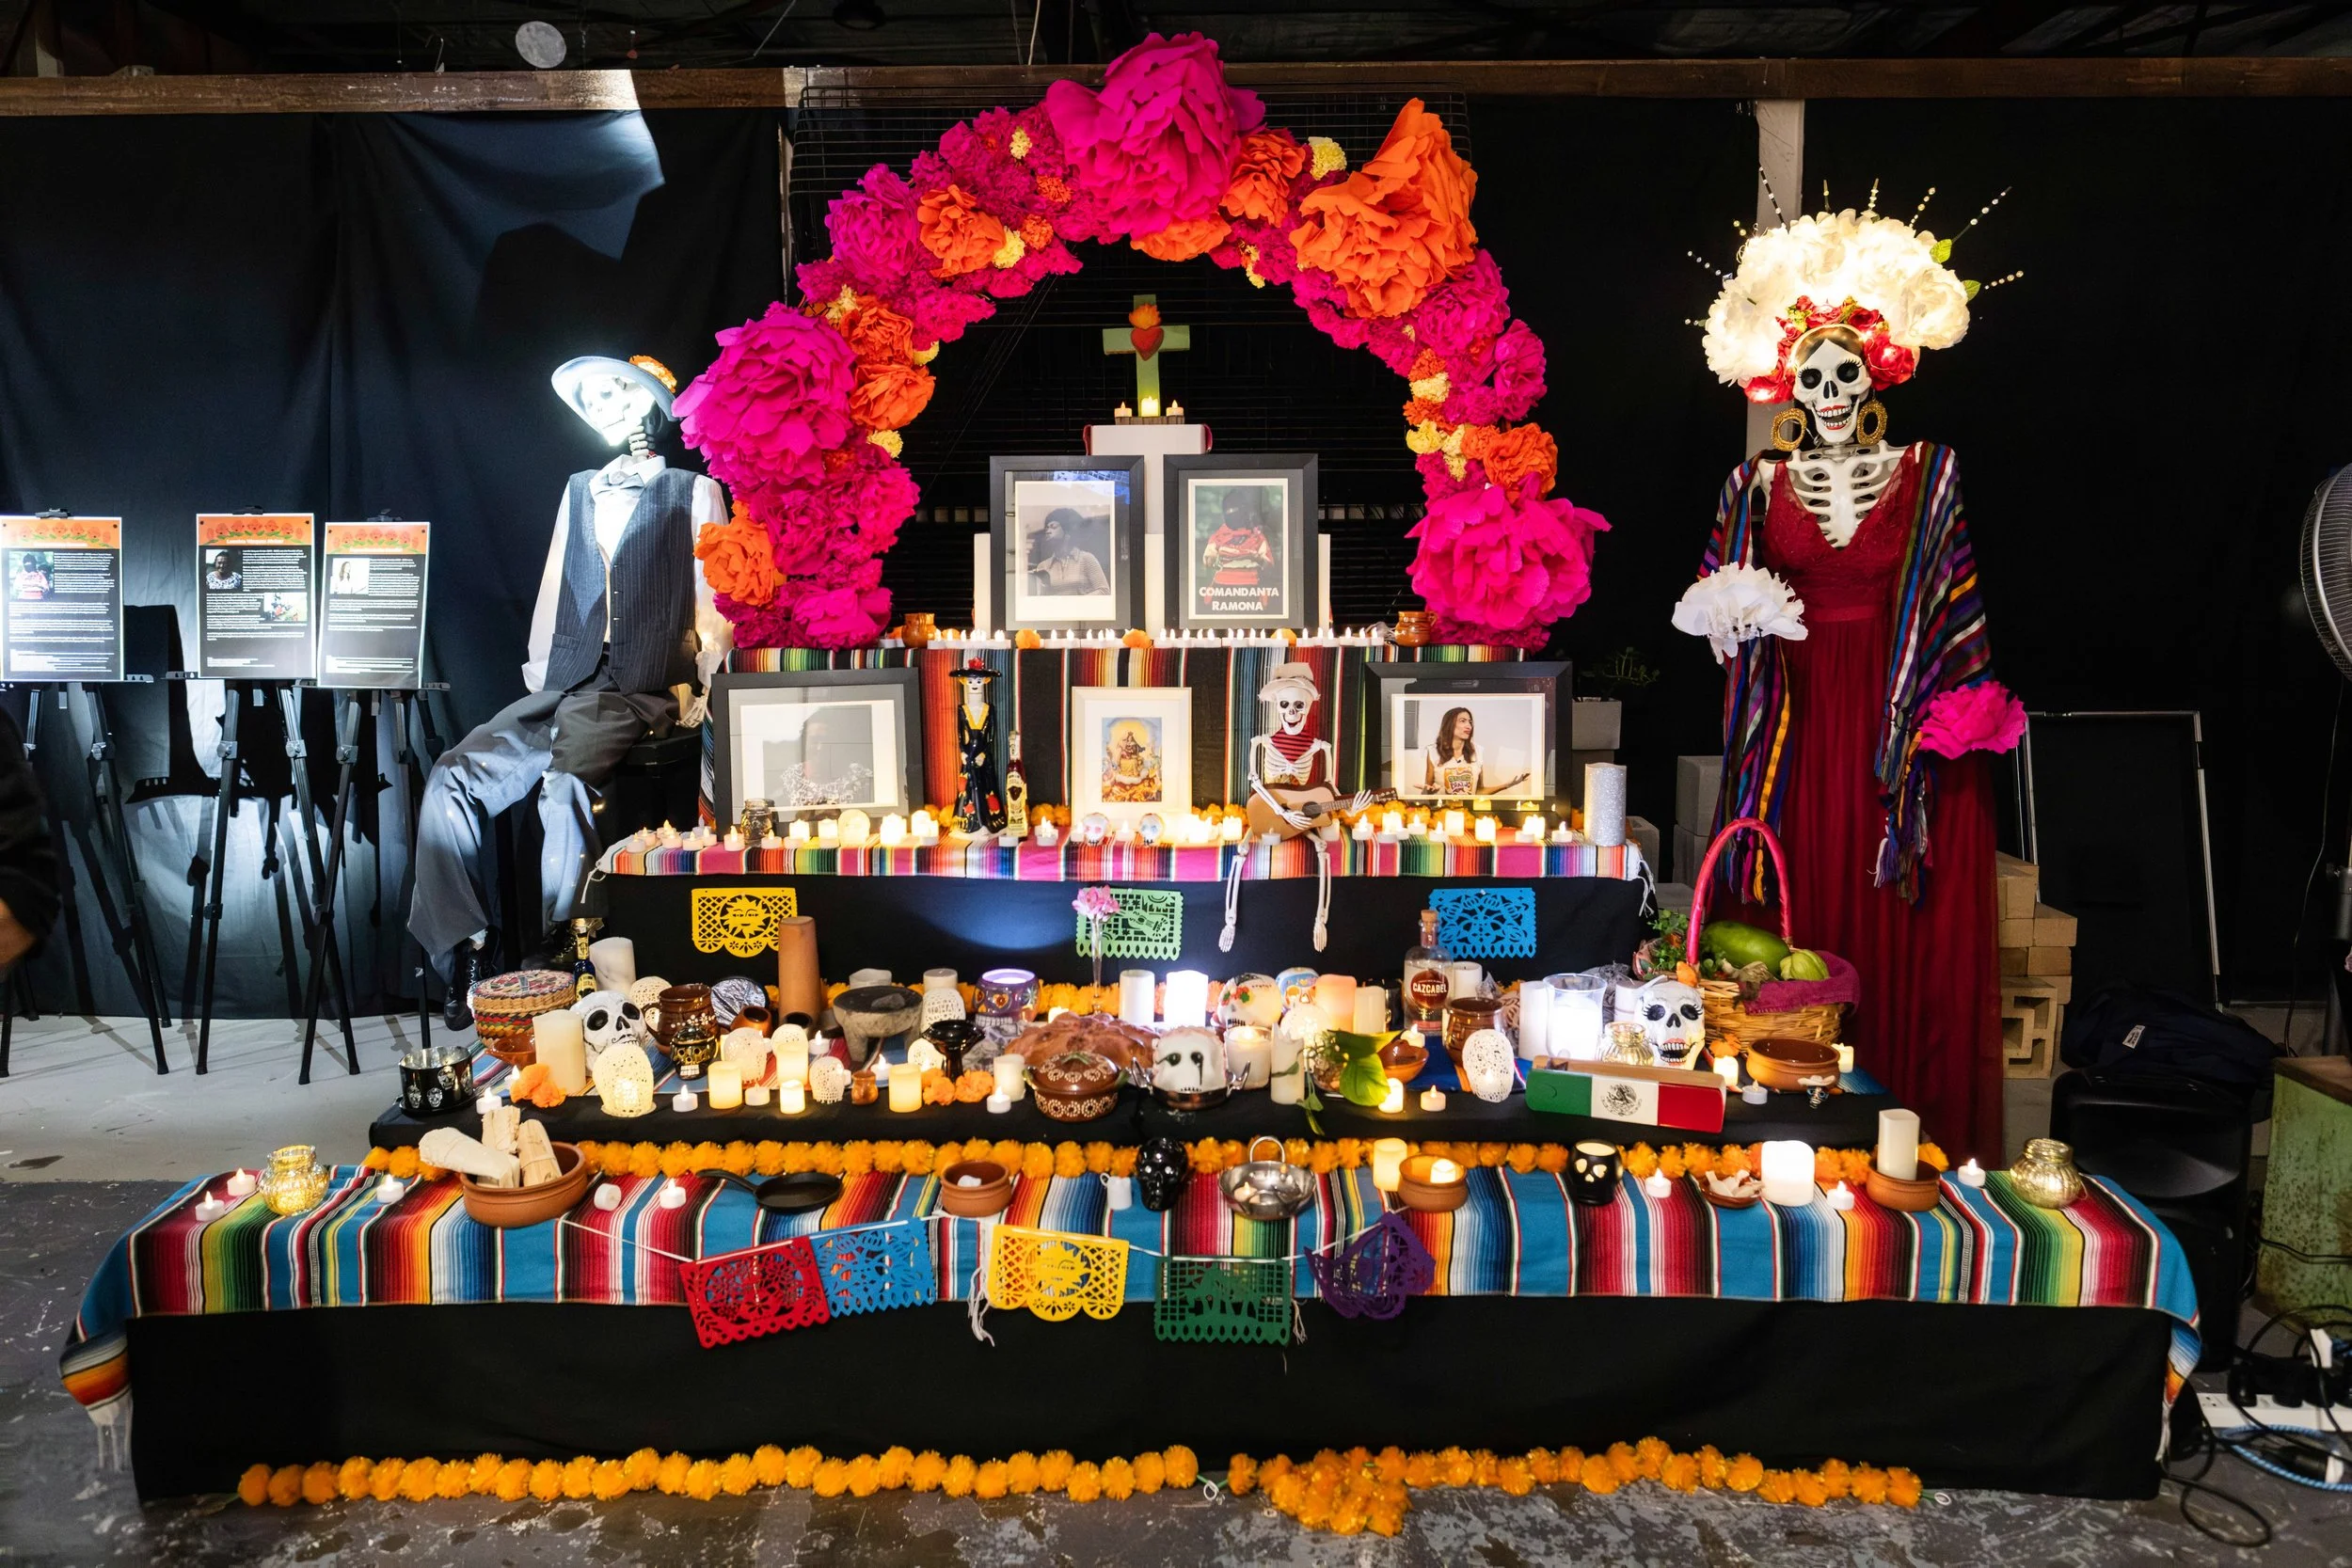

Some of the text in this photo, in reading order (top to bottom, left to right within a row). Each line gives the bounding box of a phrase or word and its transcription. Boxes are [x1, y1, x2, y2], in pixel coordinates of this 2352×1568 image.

[1199, 586, 1279, 597] COMANDANTA
[1212, 600, 1263, 611] RAMONA
[1412, 982, 1447, 994] CAZCABEL
